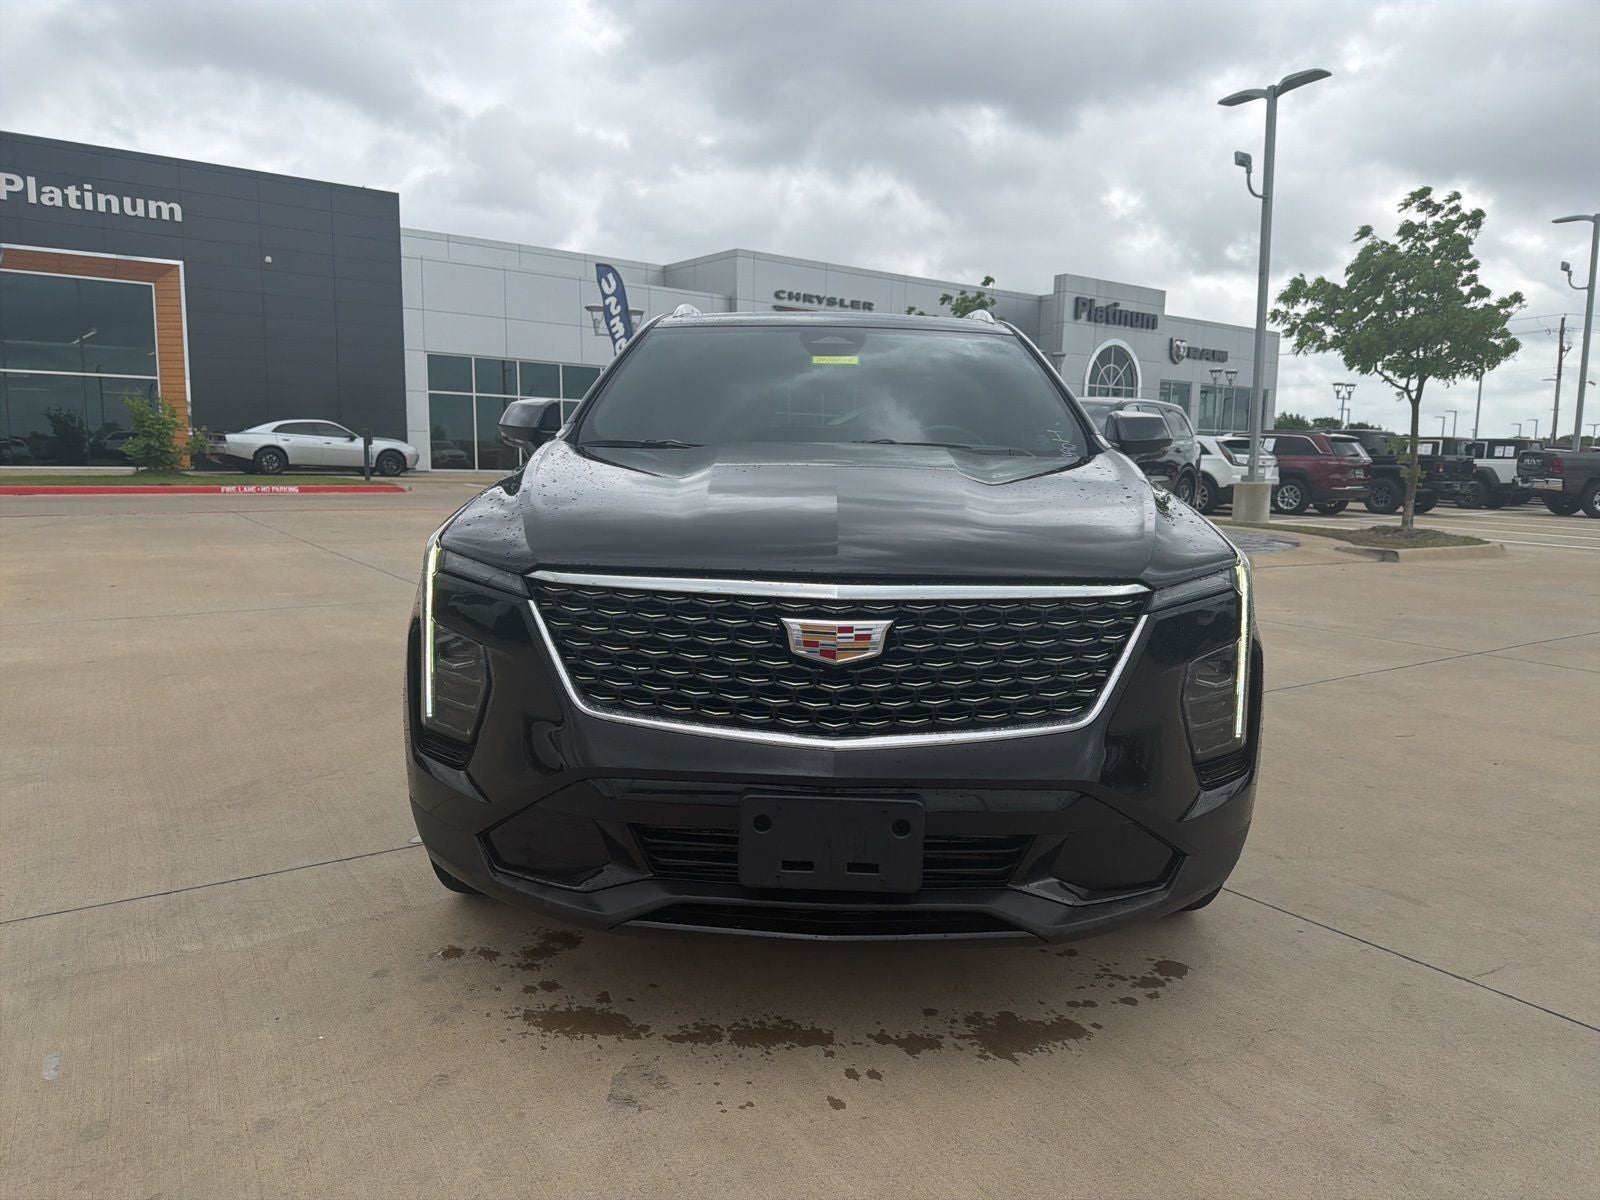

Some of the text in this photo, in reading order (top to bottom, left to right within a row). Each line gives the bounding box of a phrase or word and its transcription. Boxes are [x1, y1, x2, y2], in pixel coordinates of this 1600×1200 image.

[0, 172, 183, 222] Platinum
[774, 289, 875, 311] CHRYSLER
[1074, 296, 1159, 331] Platinum
[1186, 346, 1229, 363] RAM
[221, 485, 299, 493] FIRE LANE NO PARKING
